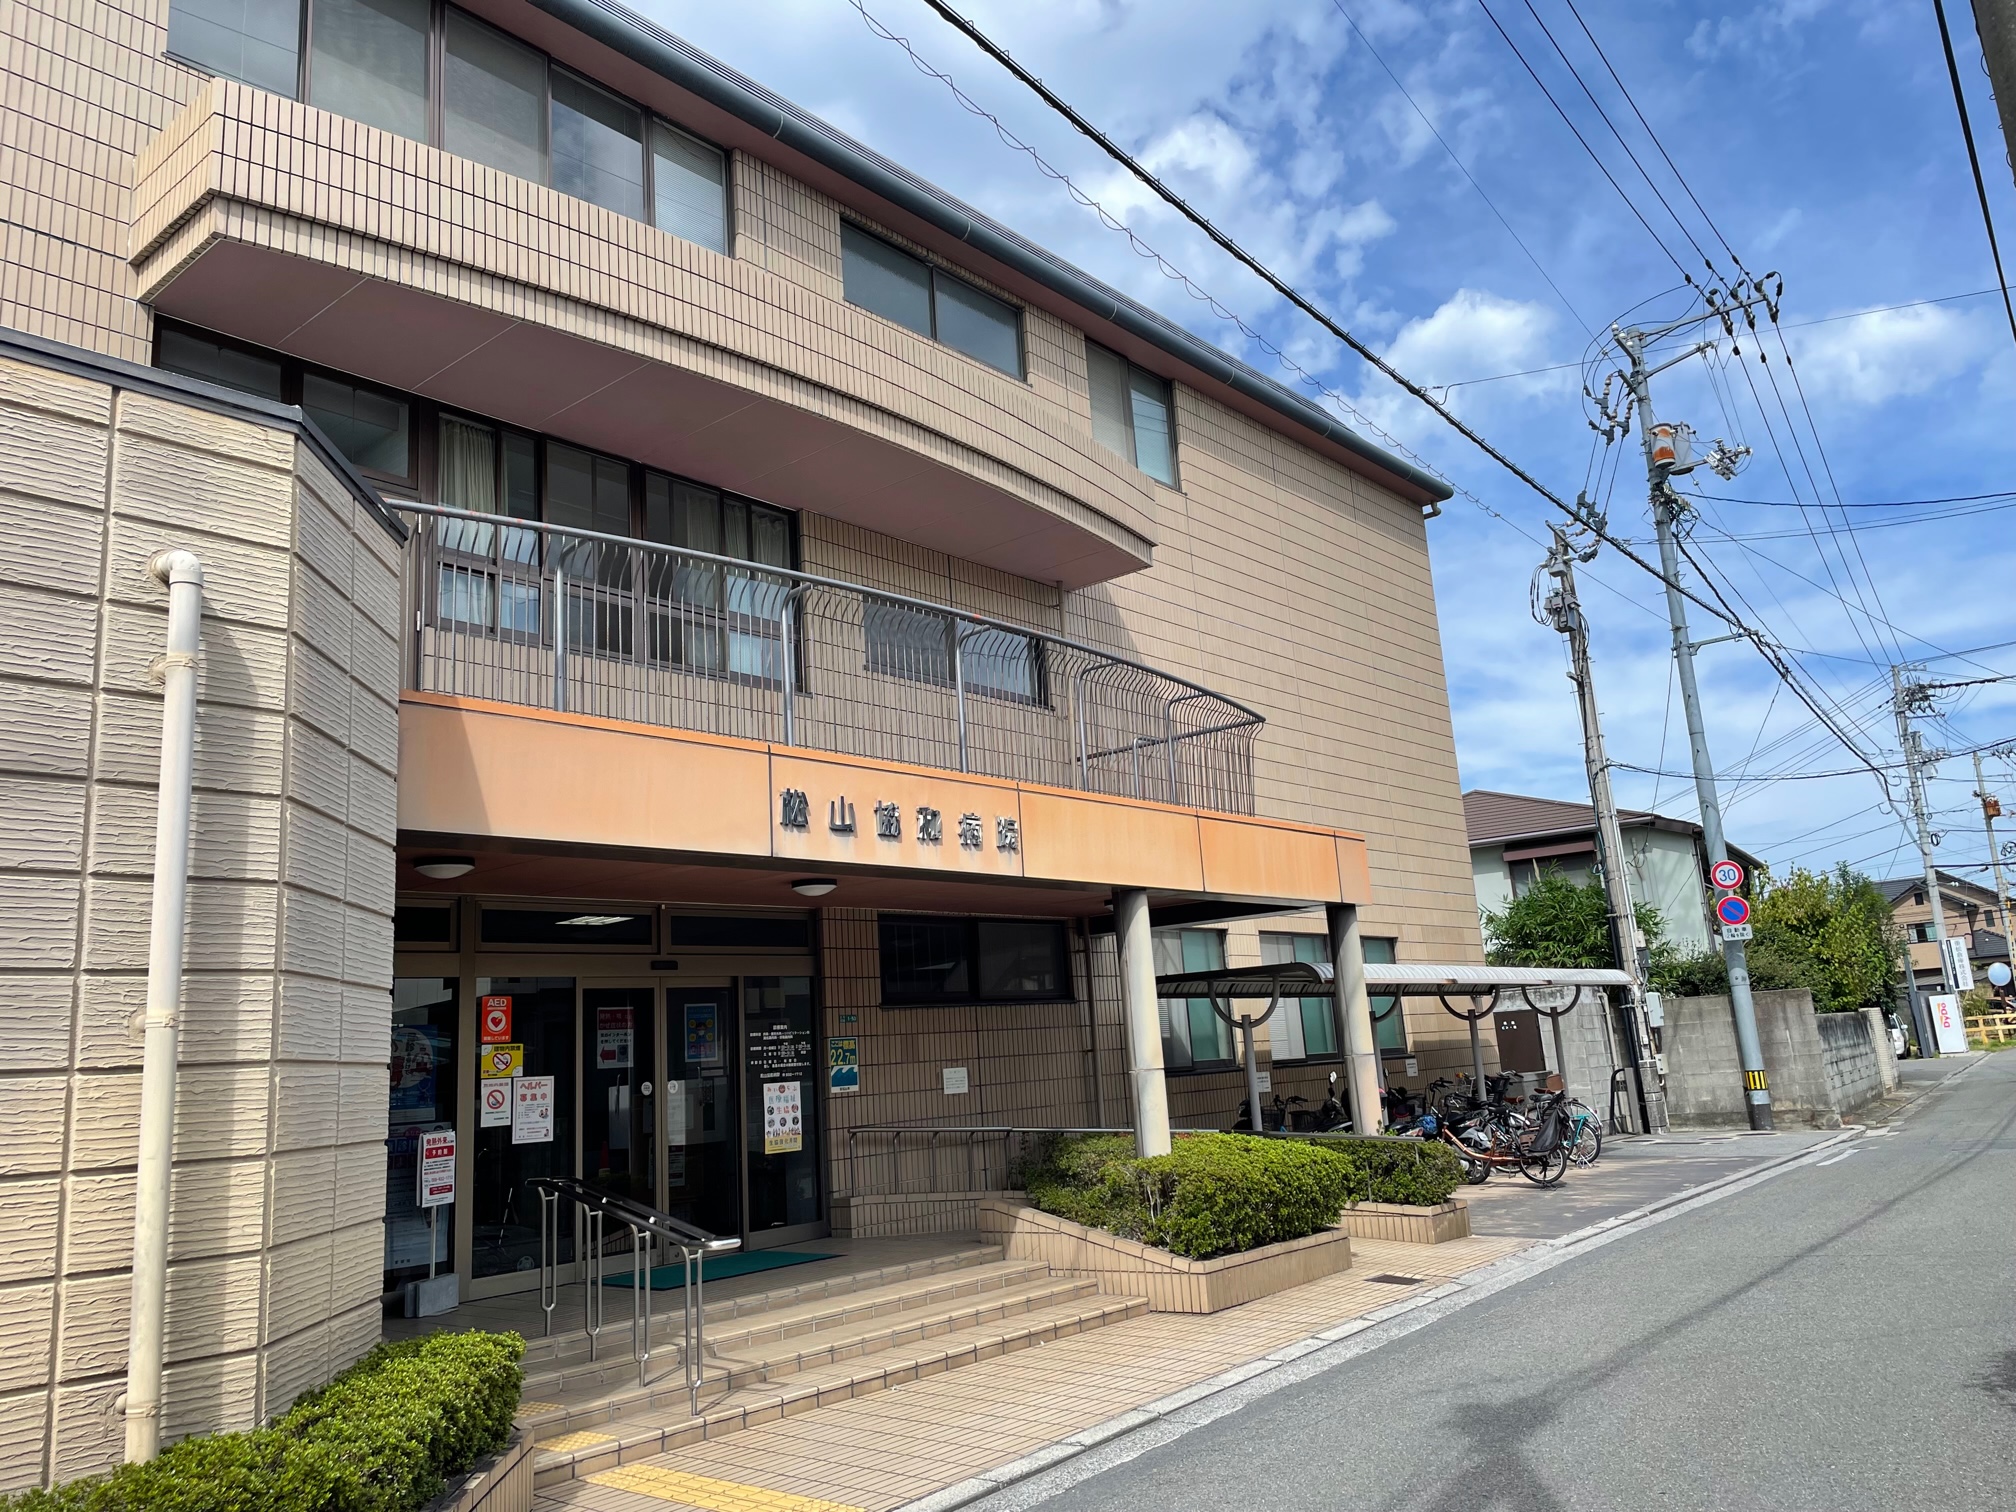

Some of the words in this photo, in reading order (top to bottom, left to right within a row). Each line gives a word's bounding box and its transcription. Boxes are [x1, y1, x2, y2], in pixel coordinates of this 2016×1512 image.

[779, 788, 1019, 849] 松山協和病院
[1718, 868, 1736, 881] 30
[487, 998, 507, 1007] AED
[1941, 1002, 1951, 1028] DyDo
